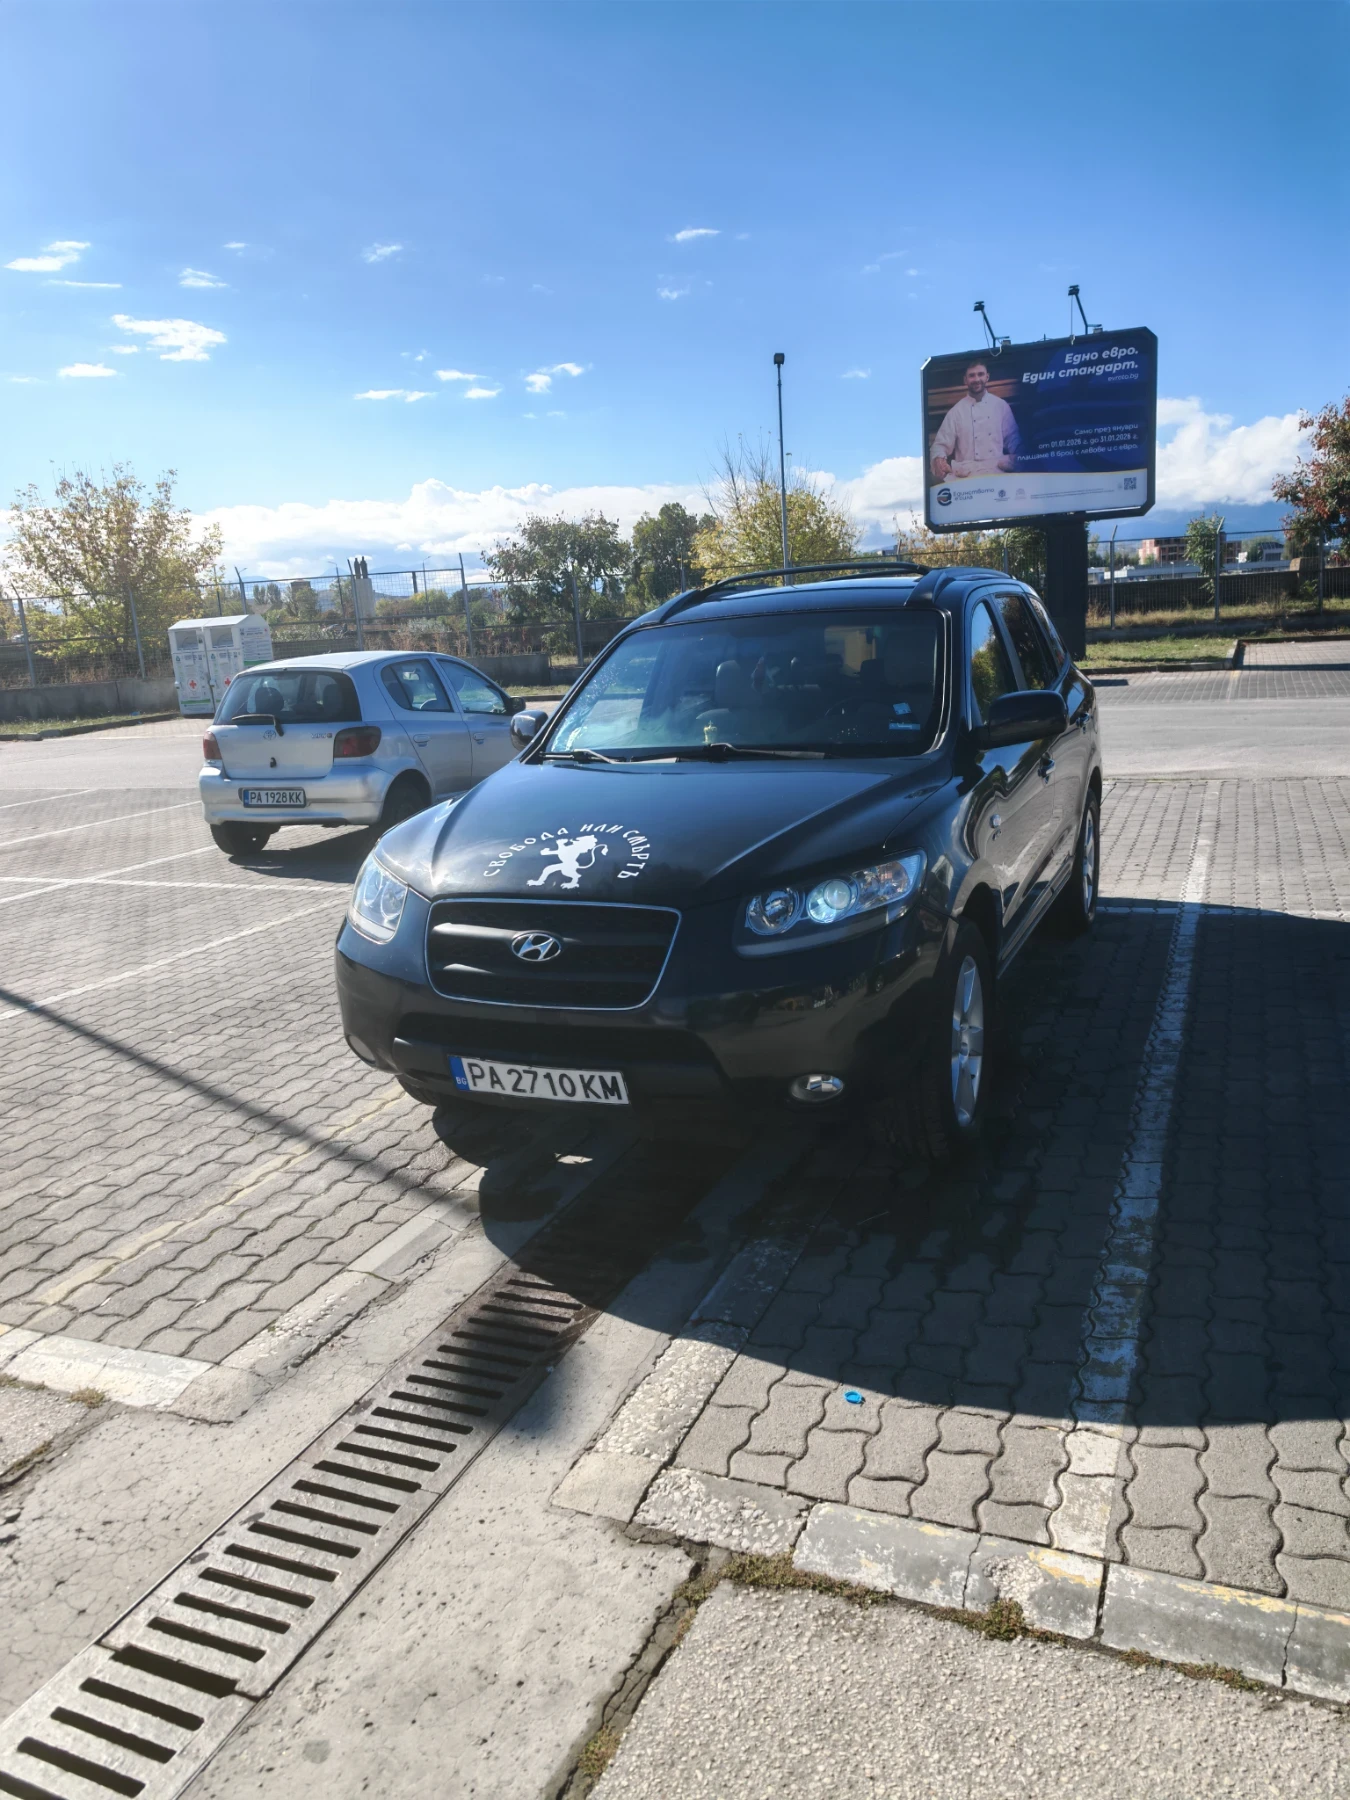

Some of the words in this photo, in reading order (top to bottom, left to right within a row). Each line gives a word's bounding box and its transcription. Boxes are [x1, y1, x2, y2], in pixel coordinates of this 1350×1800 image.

[1064, 352, 1098, 365] Едно
[1102, 346, 1139, 359] евро.
[1022, 370, 1056, 384] Един
[1058, 360, 1138, 378] стандарт.
[483, 827, 569, 877] СВОБОДА
[455, 1076, 468, 1085] BG
